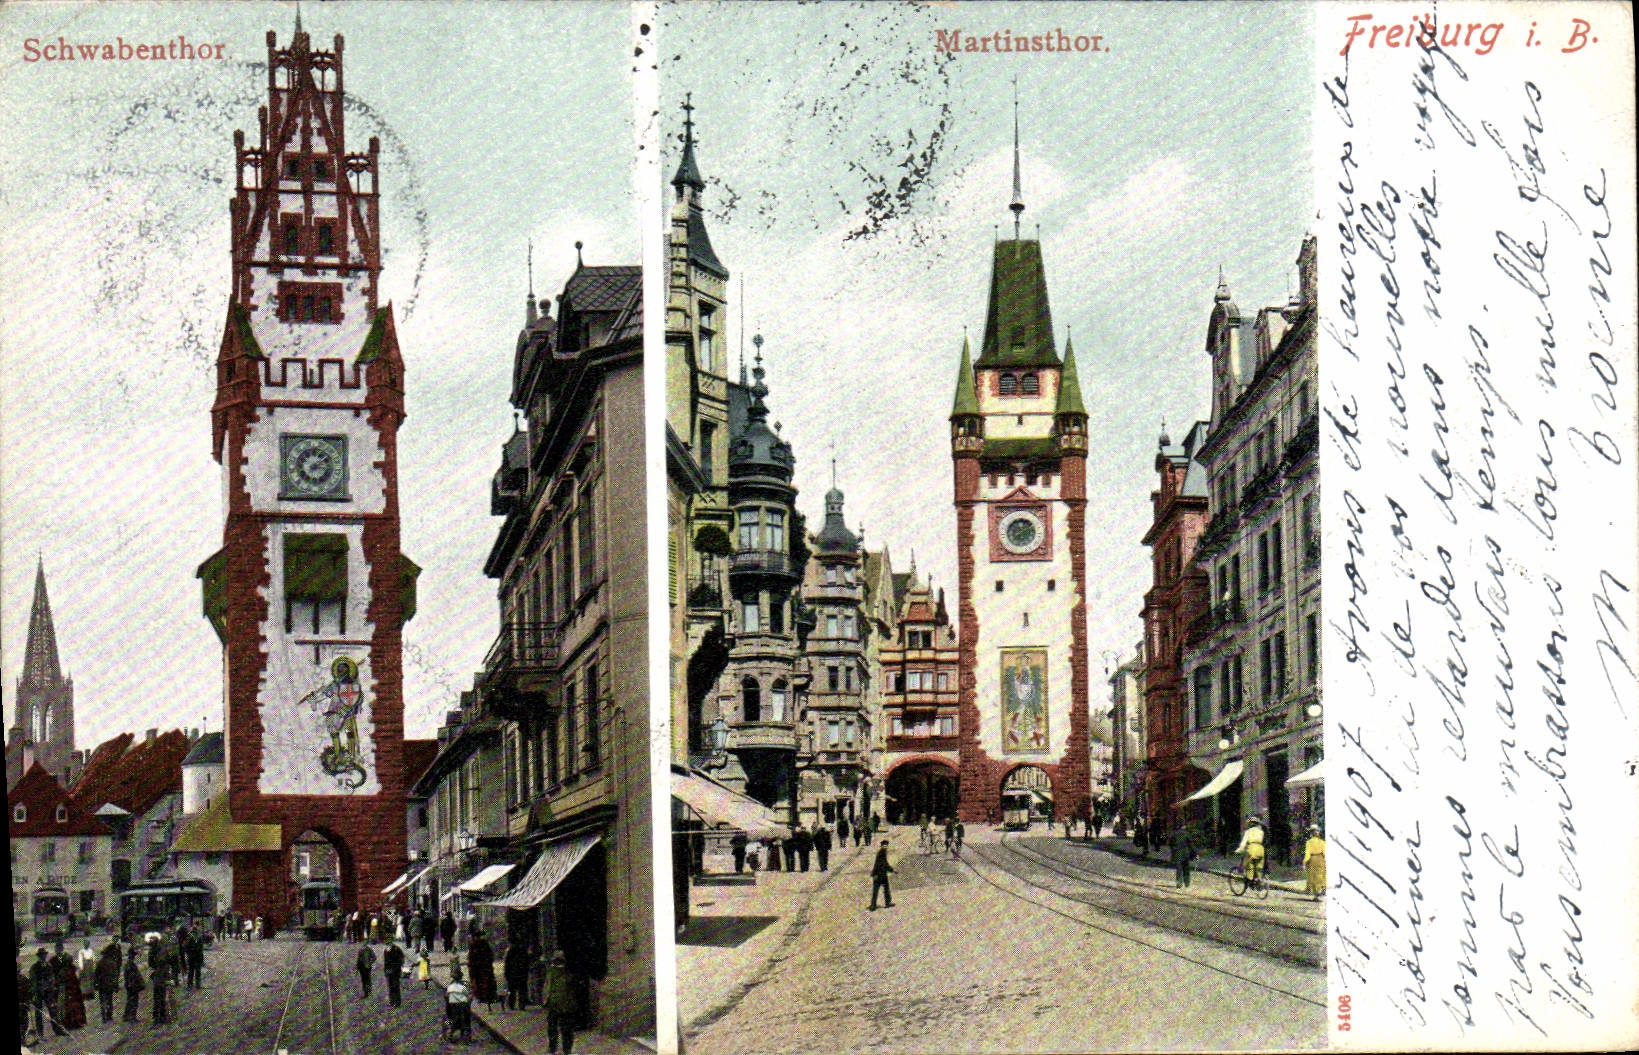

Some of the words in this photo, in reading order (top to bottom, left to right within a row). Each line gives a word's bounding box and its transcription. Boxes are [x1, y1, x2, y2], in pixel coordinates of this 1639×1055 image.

[1322, 44, 1354, 128] de
[1319, 140, 1359, 362] heureux
[1355, 180, 1409, 457] nouvelles
[1419, 362, 1458, 525] dans
[1380, 599, 1417, 679] de
[1440, 794, 1478, 1037] sommes
[1480, 823, 1524, 879] le
